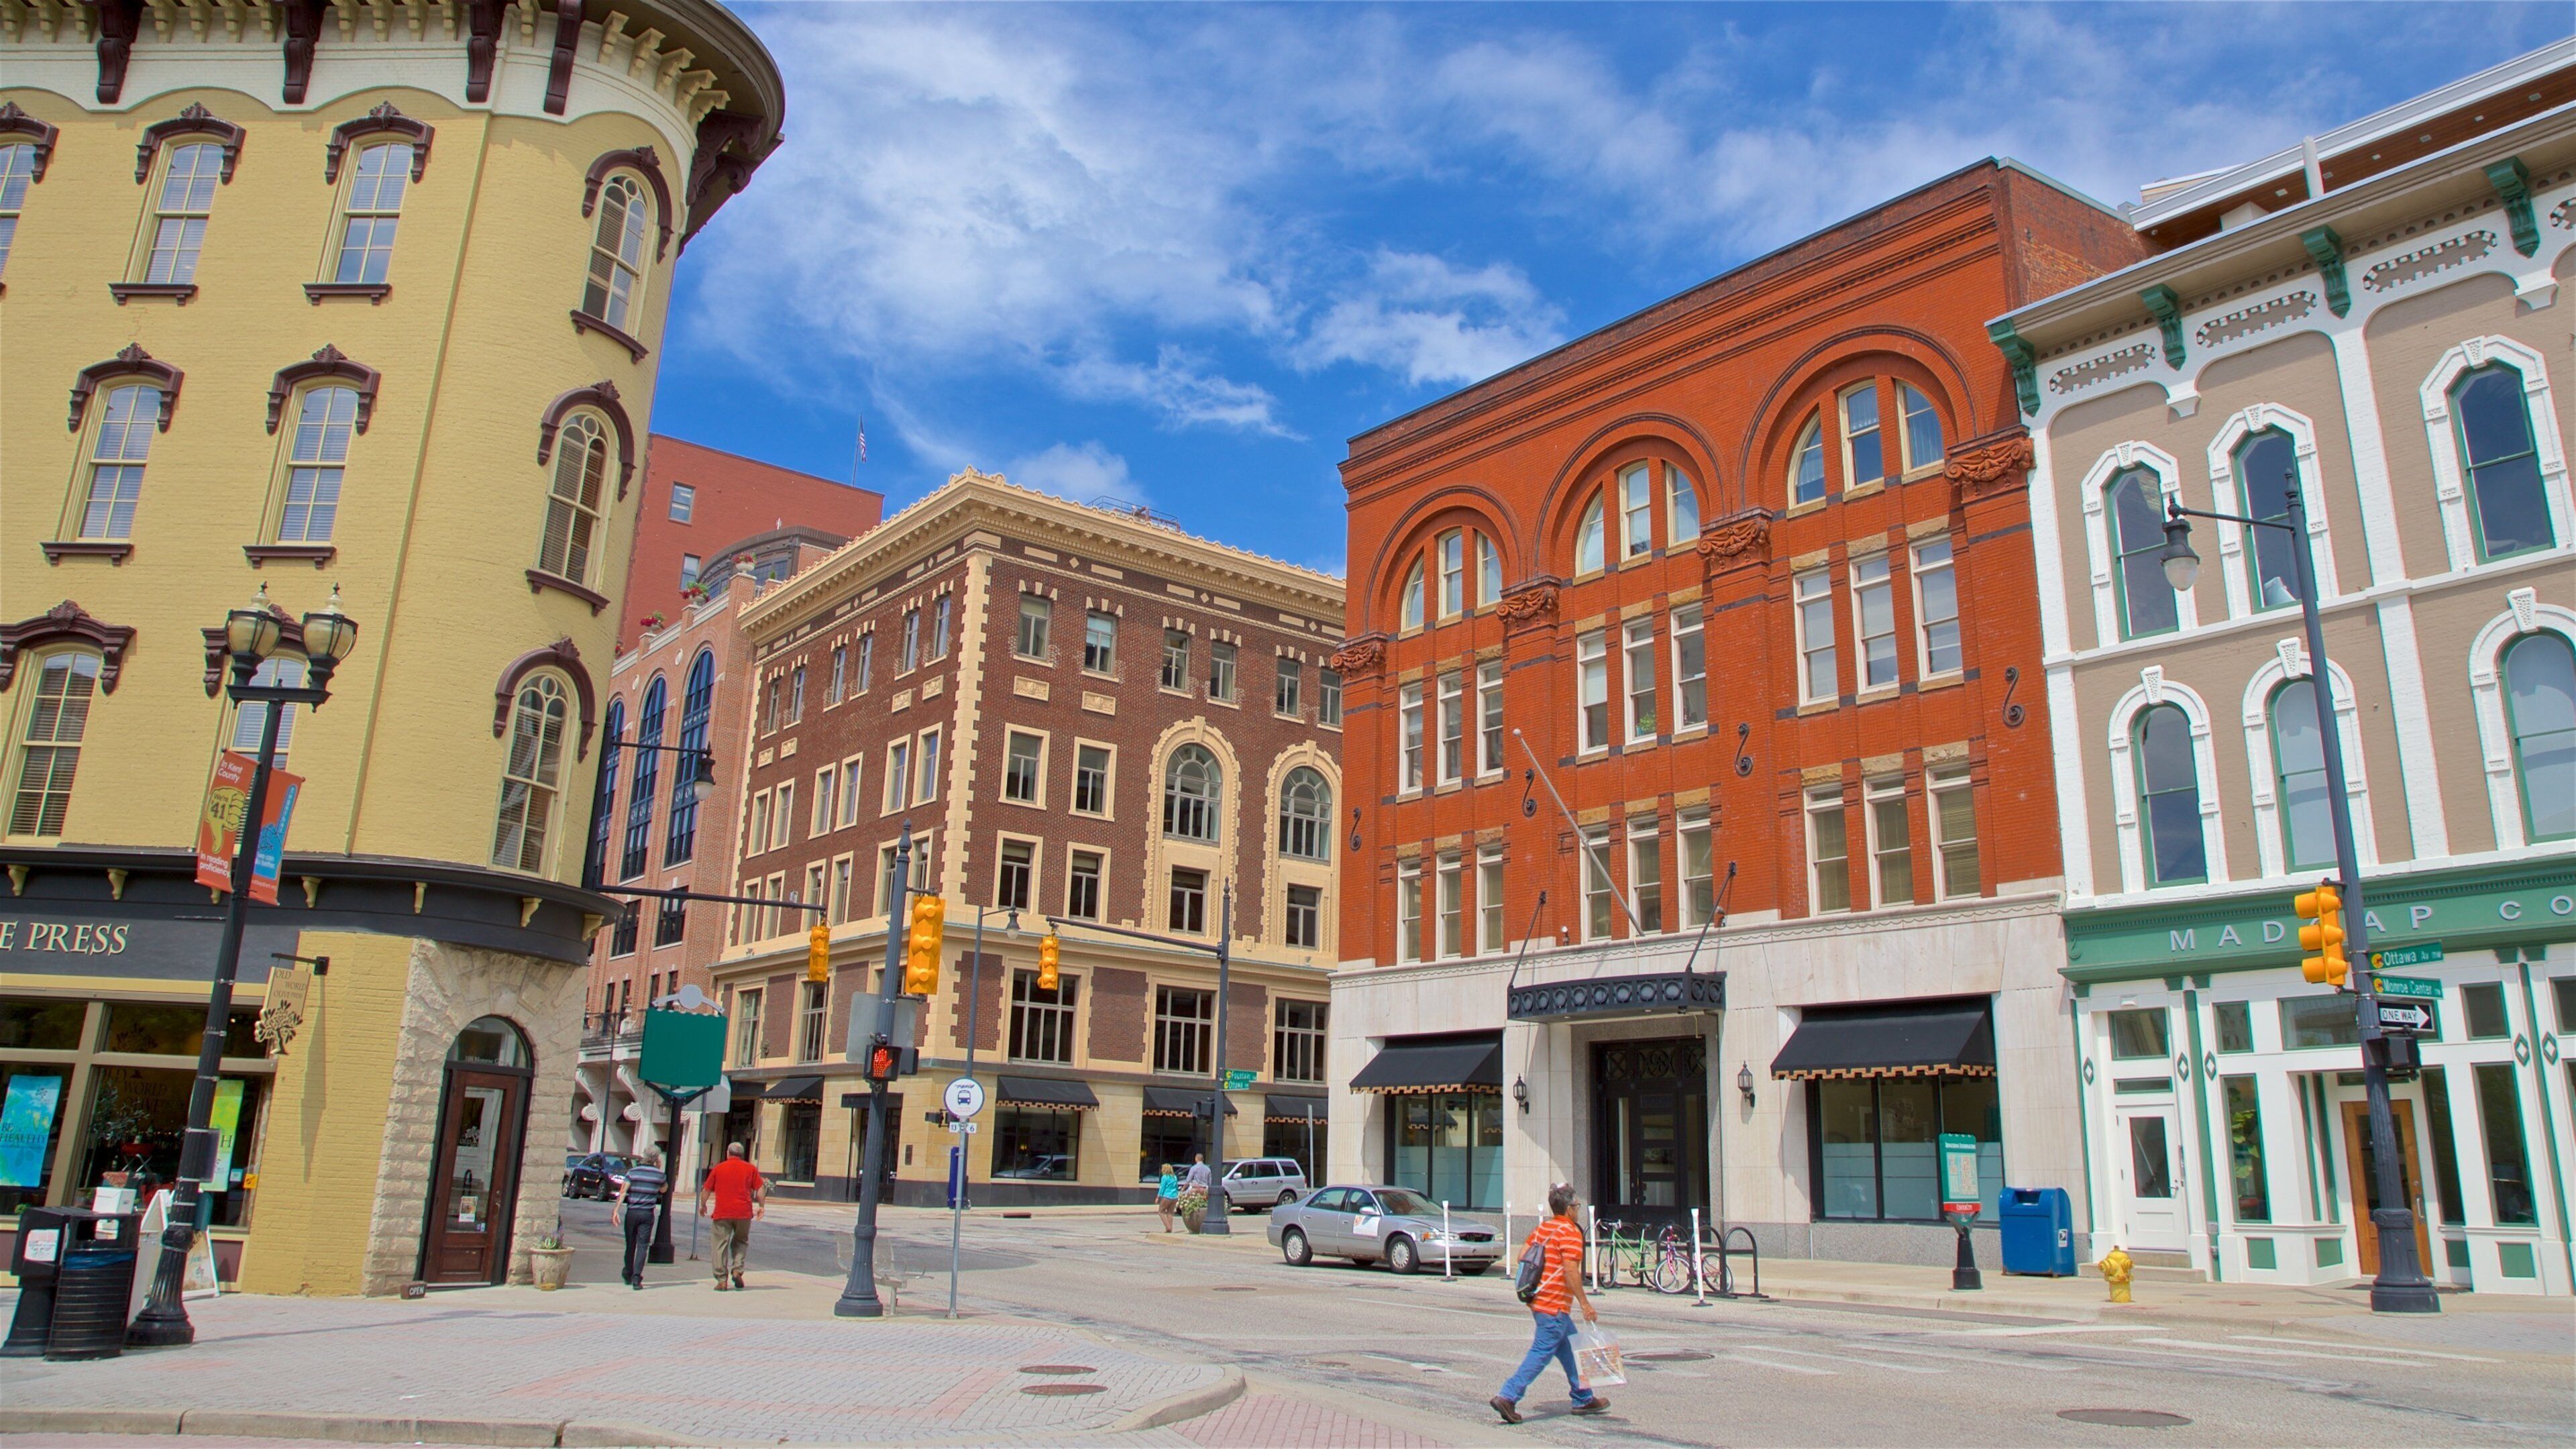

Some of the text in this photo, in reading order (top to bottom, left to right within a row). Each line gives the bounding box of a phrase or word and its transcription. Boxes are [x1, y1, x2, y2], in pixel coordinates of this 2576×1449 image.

[221, 759, 243, 773] In Kent
[218, 767, 240, 784] County
[207, 855, 228, 869] reading
[2169, 906, 2432, 952] MADAP
[23, 922, 130, 957] PRESS
[2383, 951, 2417, 966] Ottawa
[276, 969, 292, 979] OLD
[284, 980, 307, 991] WORLD
[2382, 979, 2408, 994] Monroe
[2410, 981, 2432, 995] Center
[273, 990, 290, 999] OLIVE
[2382, 1010, 2416, 1022] ONE WAY
[1231, 1071, 1251, 1079] Fountain
[1229, 1081, 1243, 1089] Ottawa
[2, 1123, 13, 1132] BE
[0, 1133, 48, 1144] HEALTHY
[409, 1285, 425, 1295] OPEN
